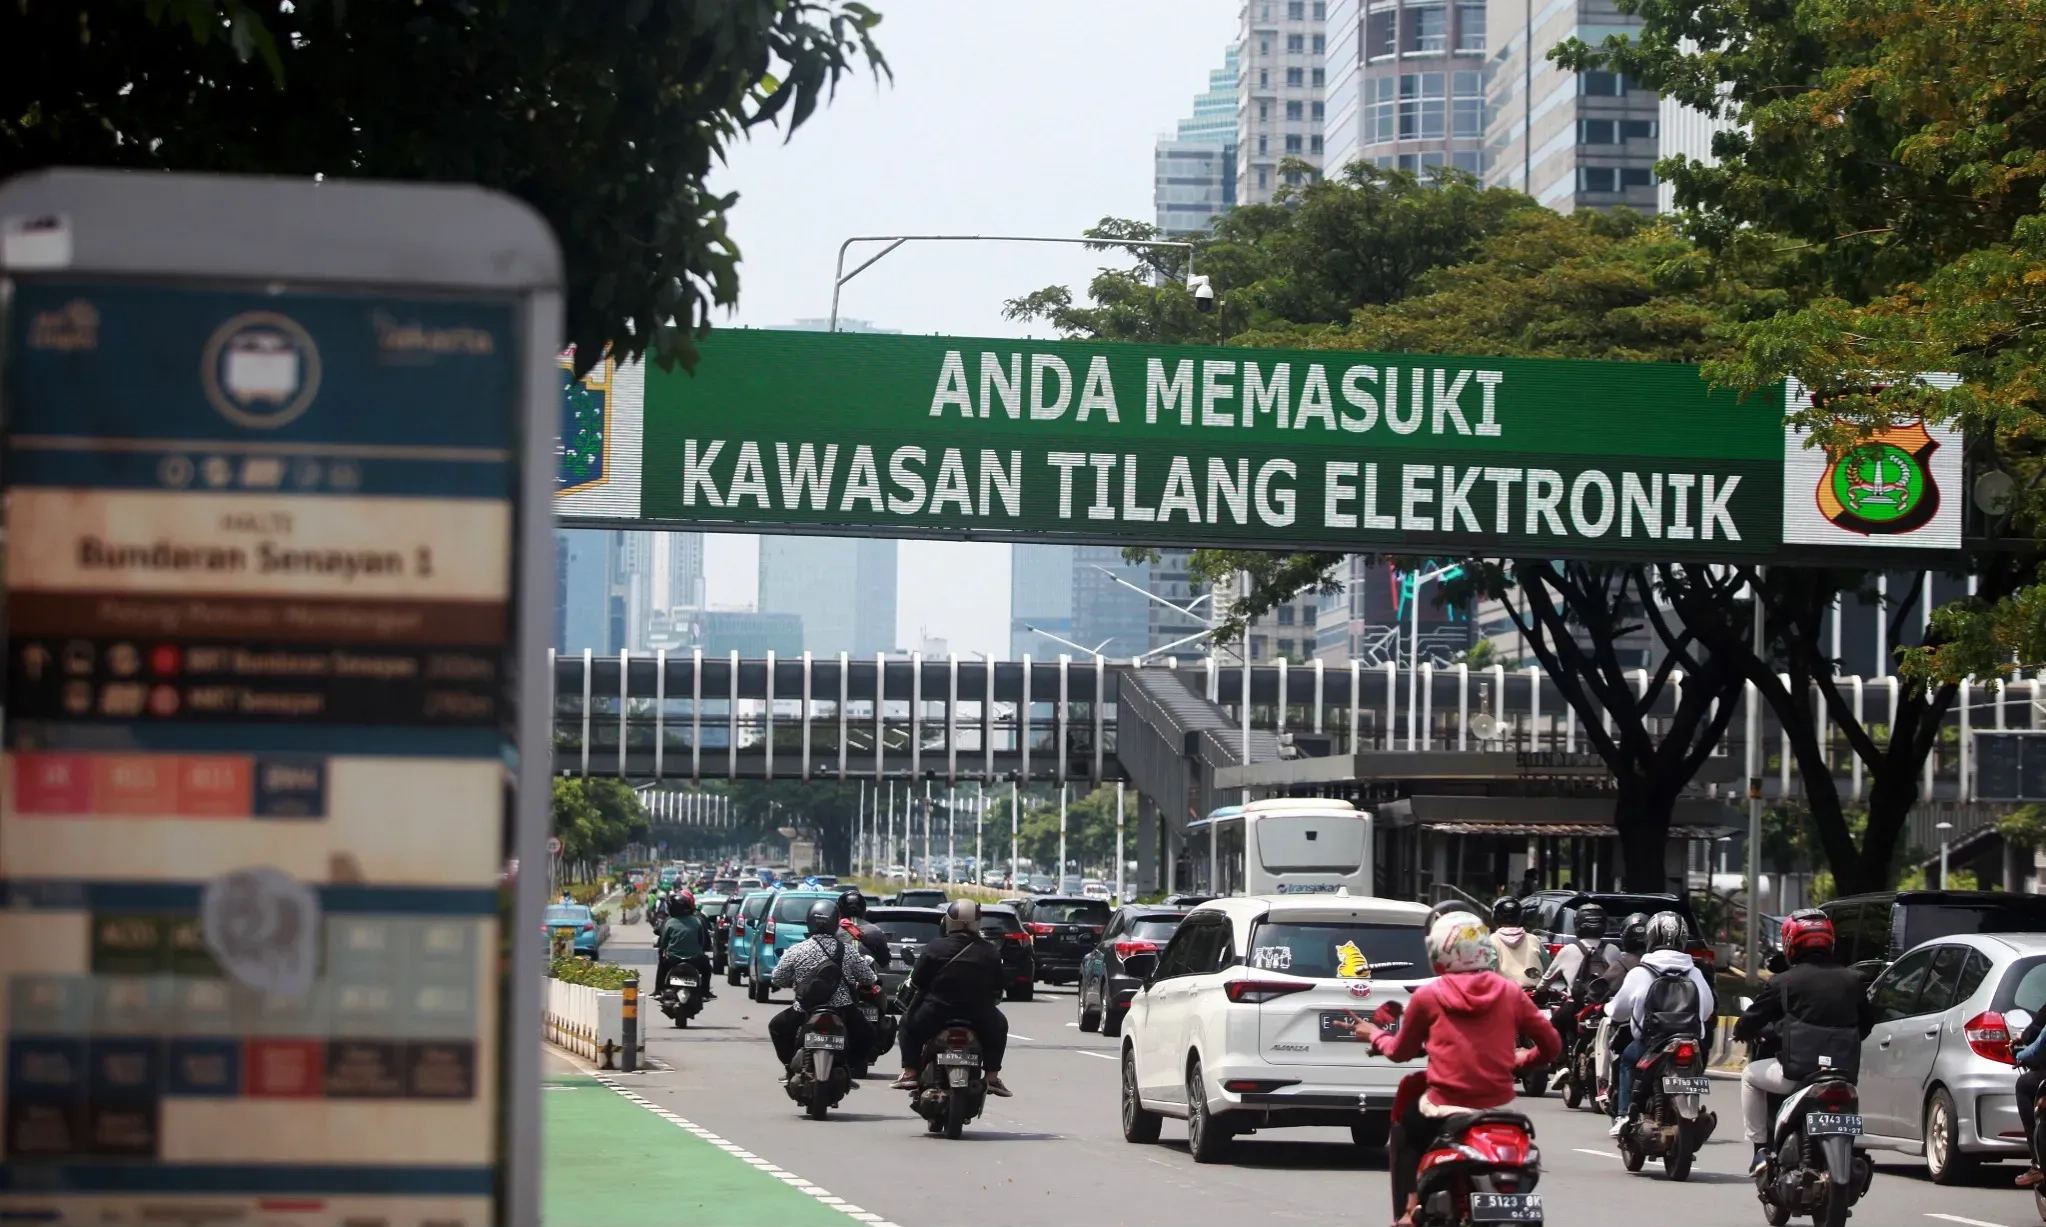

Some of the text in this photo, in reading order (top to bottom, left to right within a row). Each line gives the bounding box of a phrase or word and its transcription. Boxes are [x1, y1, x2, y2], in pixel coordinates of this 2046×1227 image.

[929, 349, 1504, 438] ANDA MEMASUKI
[683, 438, 1743, 542] KAWASAN TILANG ELEKTRONIK
[77, 537, 432, 583] Bundaran Senayan 1
[1288, 882, 1348, 893] transjakart
[1323, 1016, 1330, 1029] E
[1808, 1115, 1814, 1124] B
[1845, 1116, 1862, 1125] FIS
[1473, 1195, 1481, 1207] F
[1488, 1195, 1518, 1208] 5123
